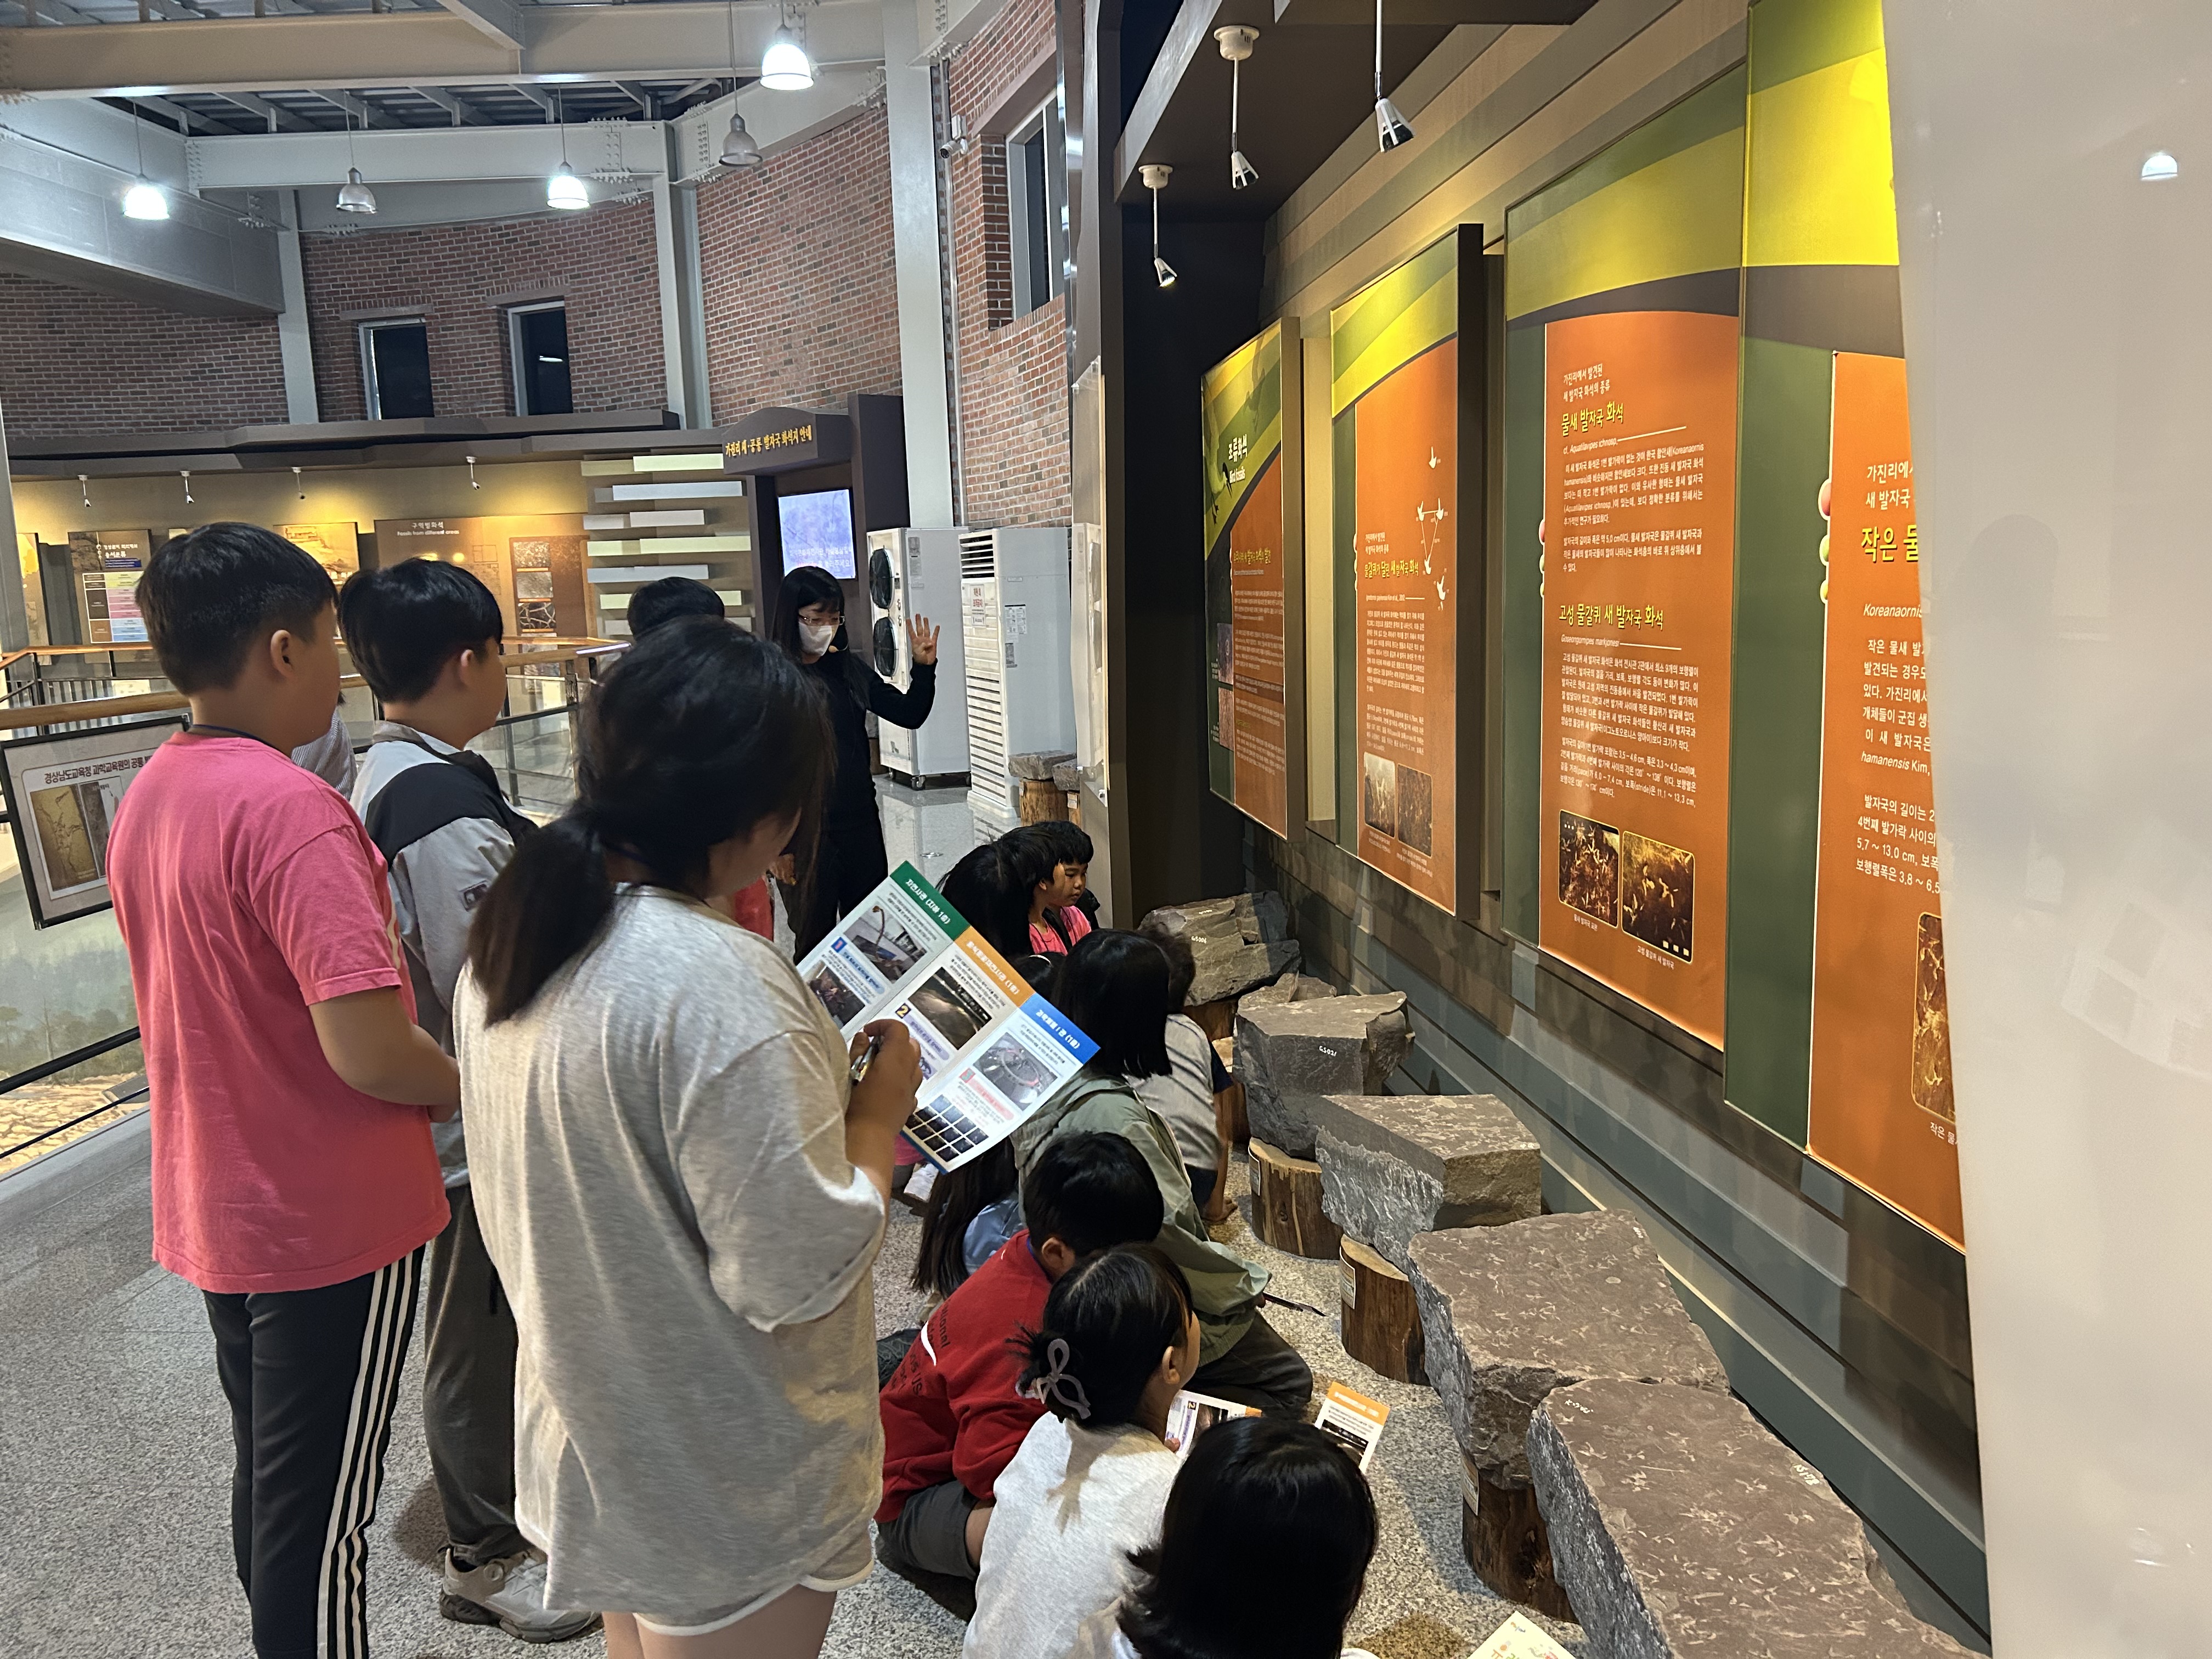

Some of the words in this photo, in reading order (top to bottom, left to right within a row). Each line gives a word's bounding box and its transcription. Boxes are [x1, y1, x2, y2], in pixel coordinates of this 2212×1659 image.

[1564, 369, 1587, 386] 가진리에서
[1588, 363, 1602, 380] 발견된
[1564, 392, 1568, 401] 새
[1569, 387, 1583, 402] 발자국
[1584, 382, 1599, 397] 화석의
[1600, 379, 1610, 394] 종류
[1561, 413, 1577, 436] 물새
[1581, 408, 1604, 432] 발자국
[1606, 401, 1623, 422] 화석
[726, 442, 740, 457] 가진리
[764, 433, 781, 449] 발자국
[782, 428, 799, 446] 화석지
[800, 425, 811, 442] 안내
[1228, 434, 1247, 462] 조류화석
[1671, 462, 1675, 471] 새
[1677, 459, 1691, 471] 발자국
[1693, 457, 1703, 468] 화석
[1867, 461, 1913, 483] 가진리에
[1688, 473, 1703, 485] 발자국
[1638, 495, 1647, 505] 보다
[1683, 489, 1703, 501] 위해서는
[1866, 492, 1875, 508] 새
[1879, 489, 1910, 510] 발자국
[1676, 529, 1680, 538] 새
[1683, 528, 1702, 540] 발자국과
[1861, 527, 1897, 562] 작은
[1664, 545, 1668, 556] 위
[1559, 605, 1574, 626] 고성
[1577, 603, 1601, 626] 물갈퀴
[1605, 605, 1613, 625] 새
[1616, 605, 1641, 629] 발자국
[1645, 605, 1663, 630] 화석
[1868, 640, 1884, 654] 작은
[1889, 641, 1907, 656] 물새
[1864, 662, 1898, 678] 발견되는
[1664, 679, 1678, 690] 변화가
[1694, 682, 1698, 692] 이
[1864, 684, 1882, 698] 있다.
[1678, 695, 1697, 708] 발가락이
[1863, 706, 1895, 723] 개체들이
[1898, 711, 1915, 726] 군집
[1669, 724, 1674, 733] 새
[1675, 725, 1696, 738] 발자국과
[1866, 729, 1873, 742] 이
[1879, 731, 1887, 744] 새
[1894, 733, 1931, 752] 발자국은
[1663, 738, 1677, 748] 크기가
[1679, 741, 1690, 752] 작다.
[44, 766, 92, 783] 경상남도교육청
[93, 759, 130, 775] 과학교육원의
[131, 757, 144, 768] 공룡
[1861, 751, 1910, 770] hamanensis
[1912, 760, 1929, 776] Kim,
[1674, 793, 1684, 803] 13.3
[1865, 794, 1897, 814] 발자국의
[1900, 803, 1926, 821] 길이는
[1858, 816, 1878, 832] 4번째
[1882, 821, 1906, 839] 발가락
[1909, 828, 1936, 847] 사이의
[1857, 838, 1869, 850] 5.7
[1883, 844, 1899, 859] 13.0
[1903, 852, 1917, 866] cm,
[1856, 859, 1897, 882] 보행렬폭은
[1899, 871, 1912, 885] 3.8
[896, 1004, 910, 1018] 2
[1319, 1046, 1336, 1057] GS021
[1930, 1122, 1944, 1139] 작은
[1948, 1131, 1958, 1146] 물
